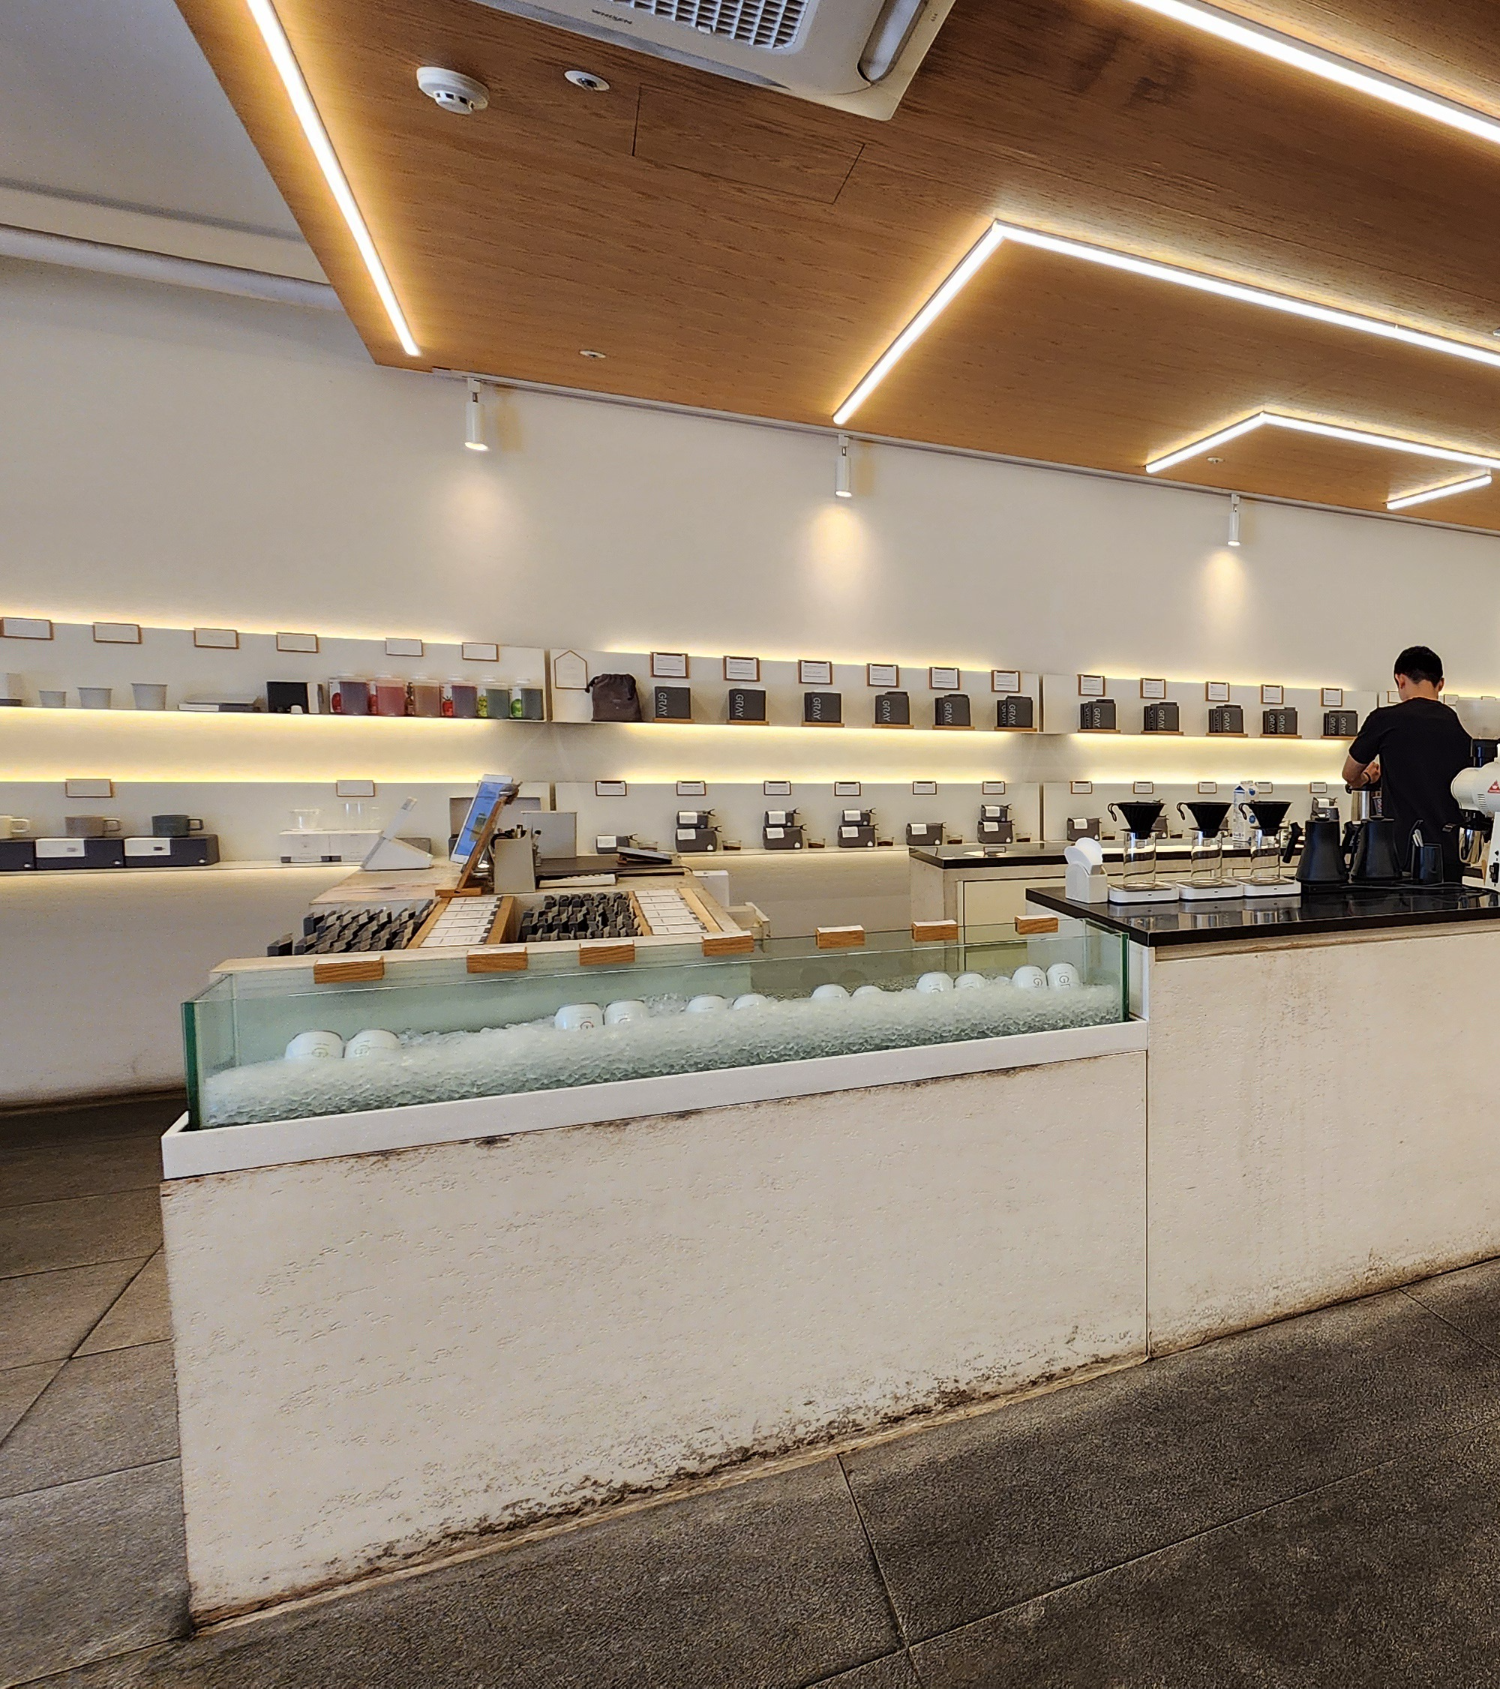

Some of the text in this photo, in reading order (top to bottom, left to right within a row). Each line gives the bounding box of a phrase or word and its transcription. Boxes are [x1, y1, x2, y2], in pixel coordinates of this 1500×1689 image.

[658, 692, 668, 716] GRAY
[735, 694, 744, 718] GRAY
[812, 697, 822, 720] GRAY
[882, 700, 891, 722] GRAY
[944, 702, 953, 724] GRAY
[1008, 704, 1017, 725] GRAY
[1093, 707, 1101, 728] GRAY
